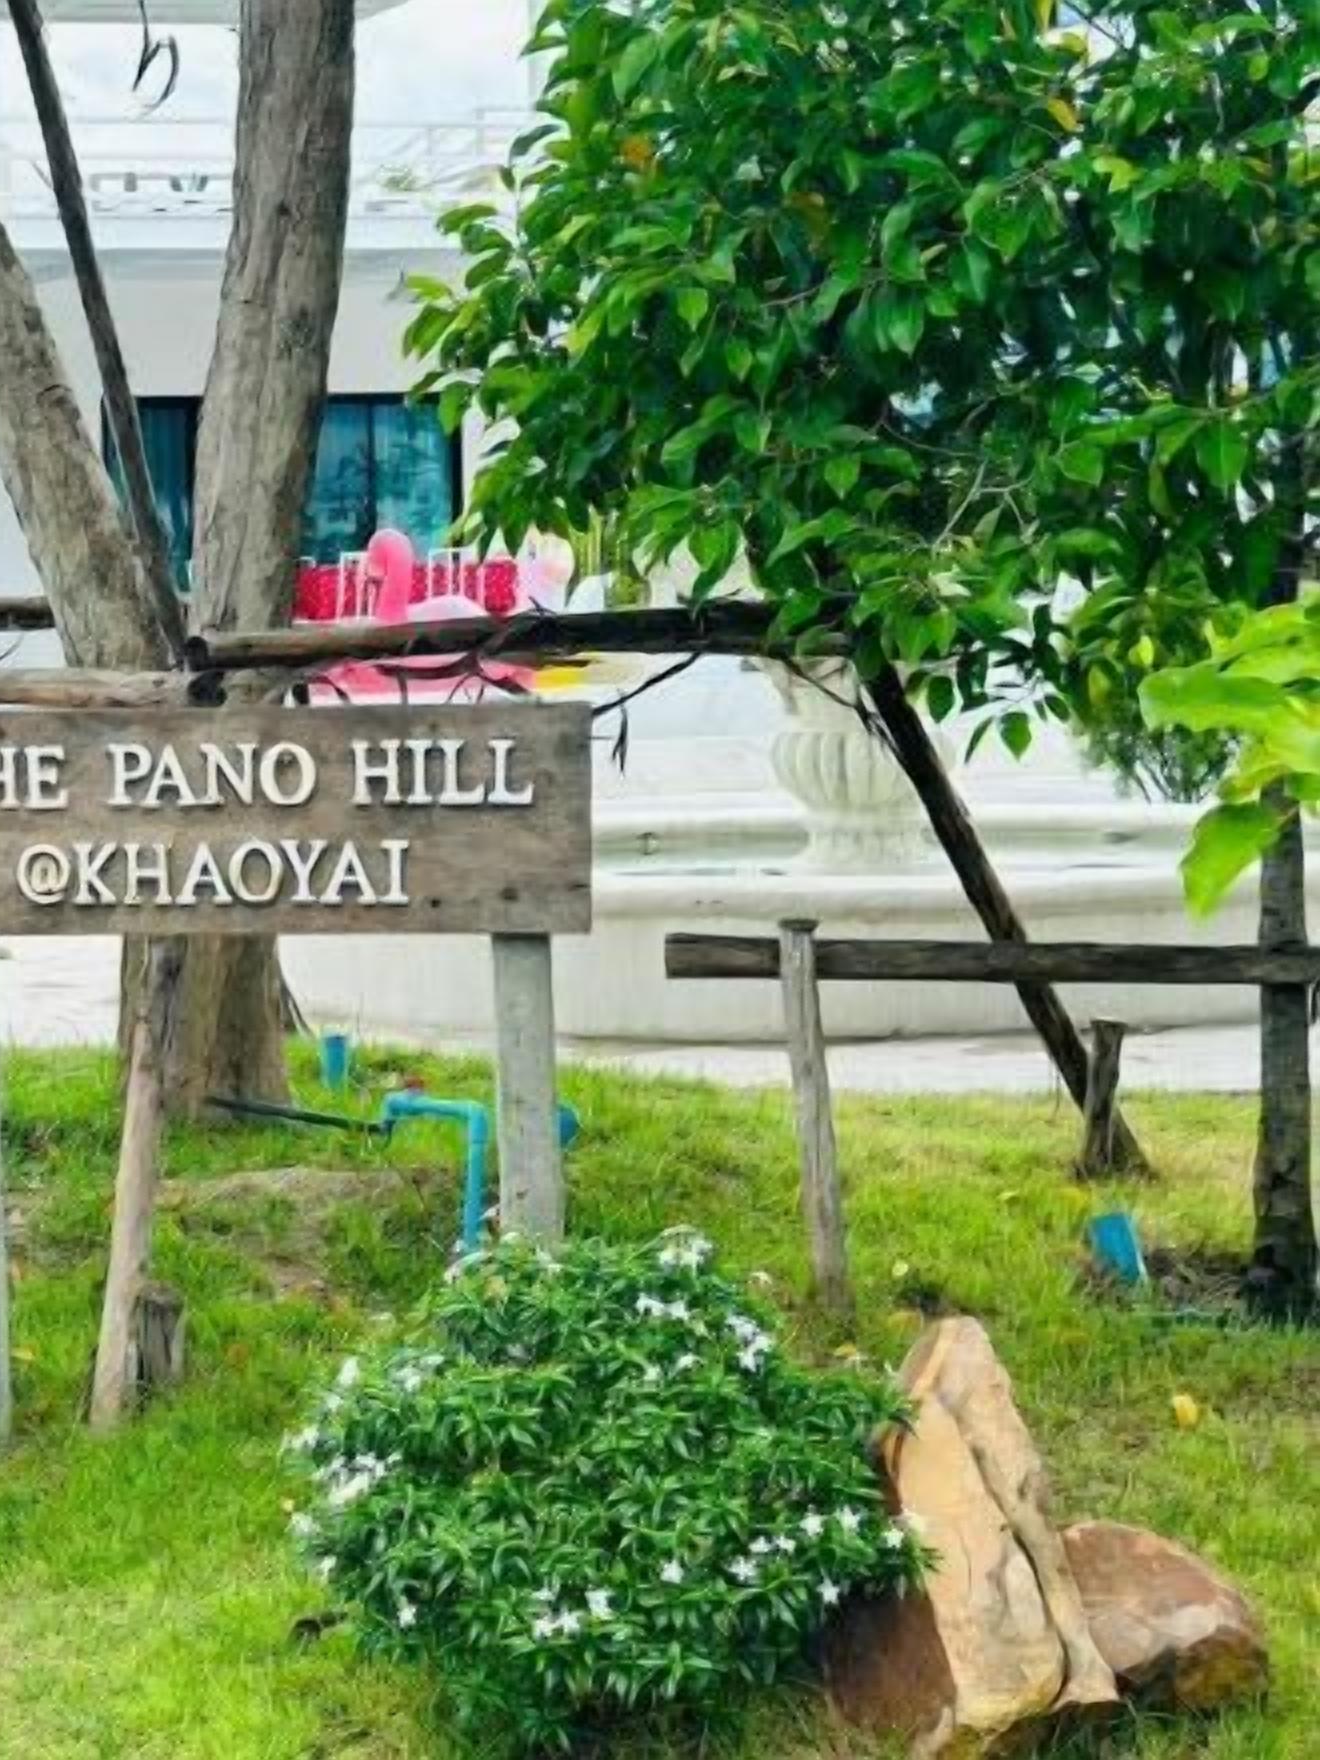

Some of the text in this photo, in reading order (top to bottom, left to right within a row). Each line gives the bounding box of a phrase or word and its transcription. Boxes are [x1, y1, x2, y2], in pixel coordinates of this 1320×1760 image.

[106, 742, 317, 807] PANO
[351, 738, 535, 805] HILL
[16, 839, 410, 905] @KHAOYAI
